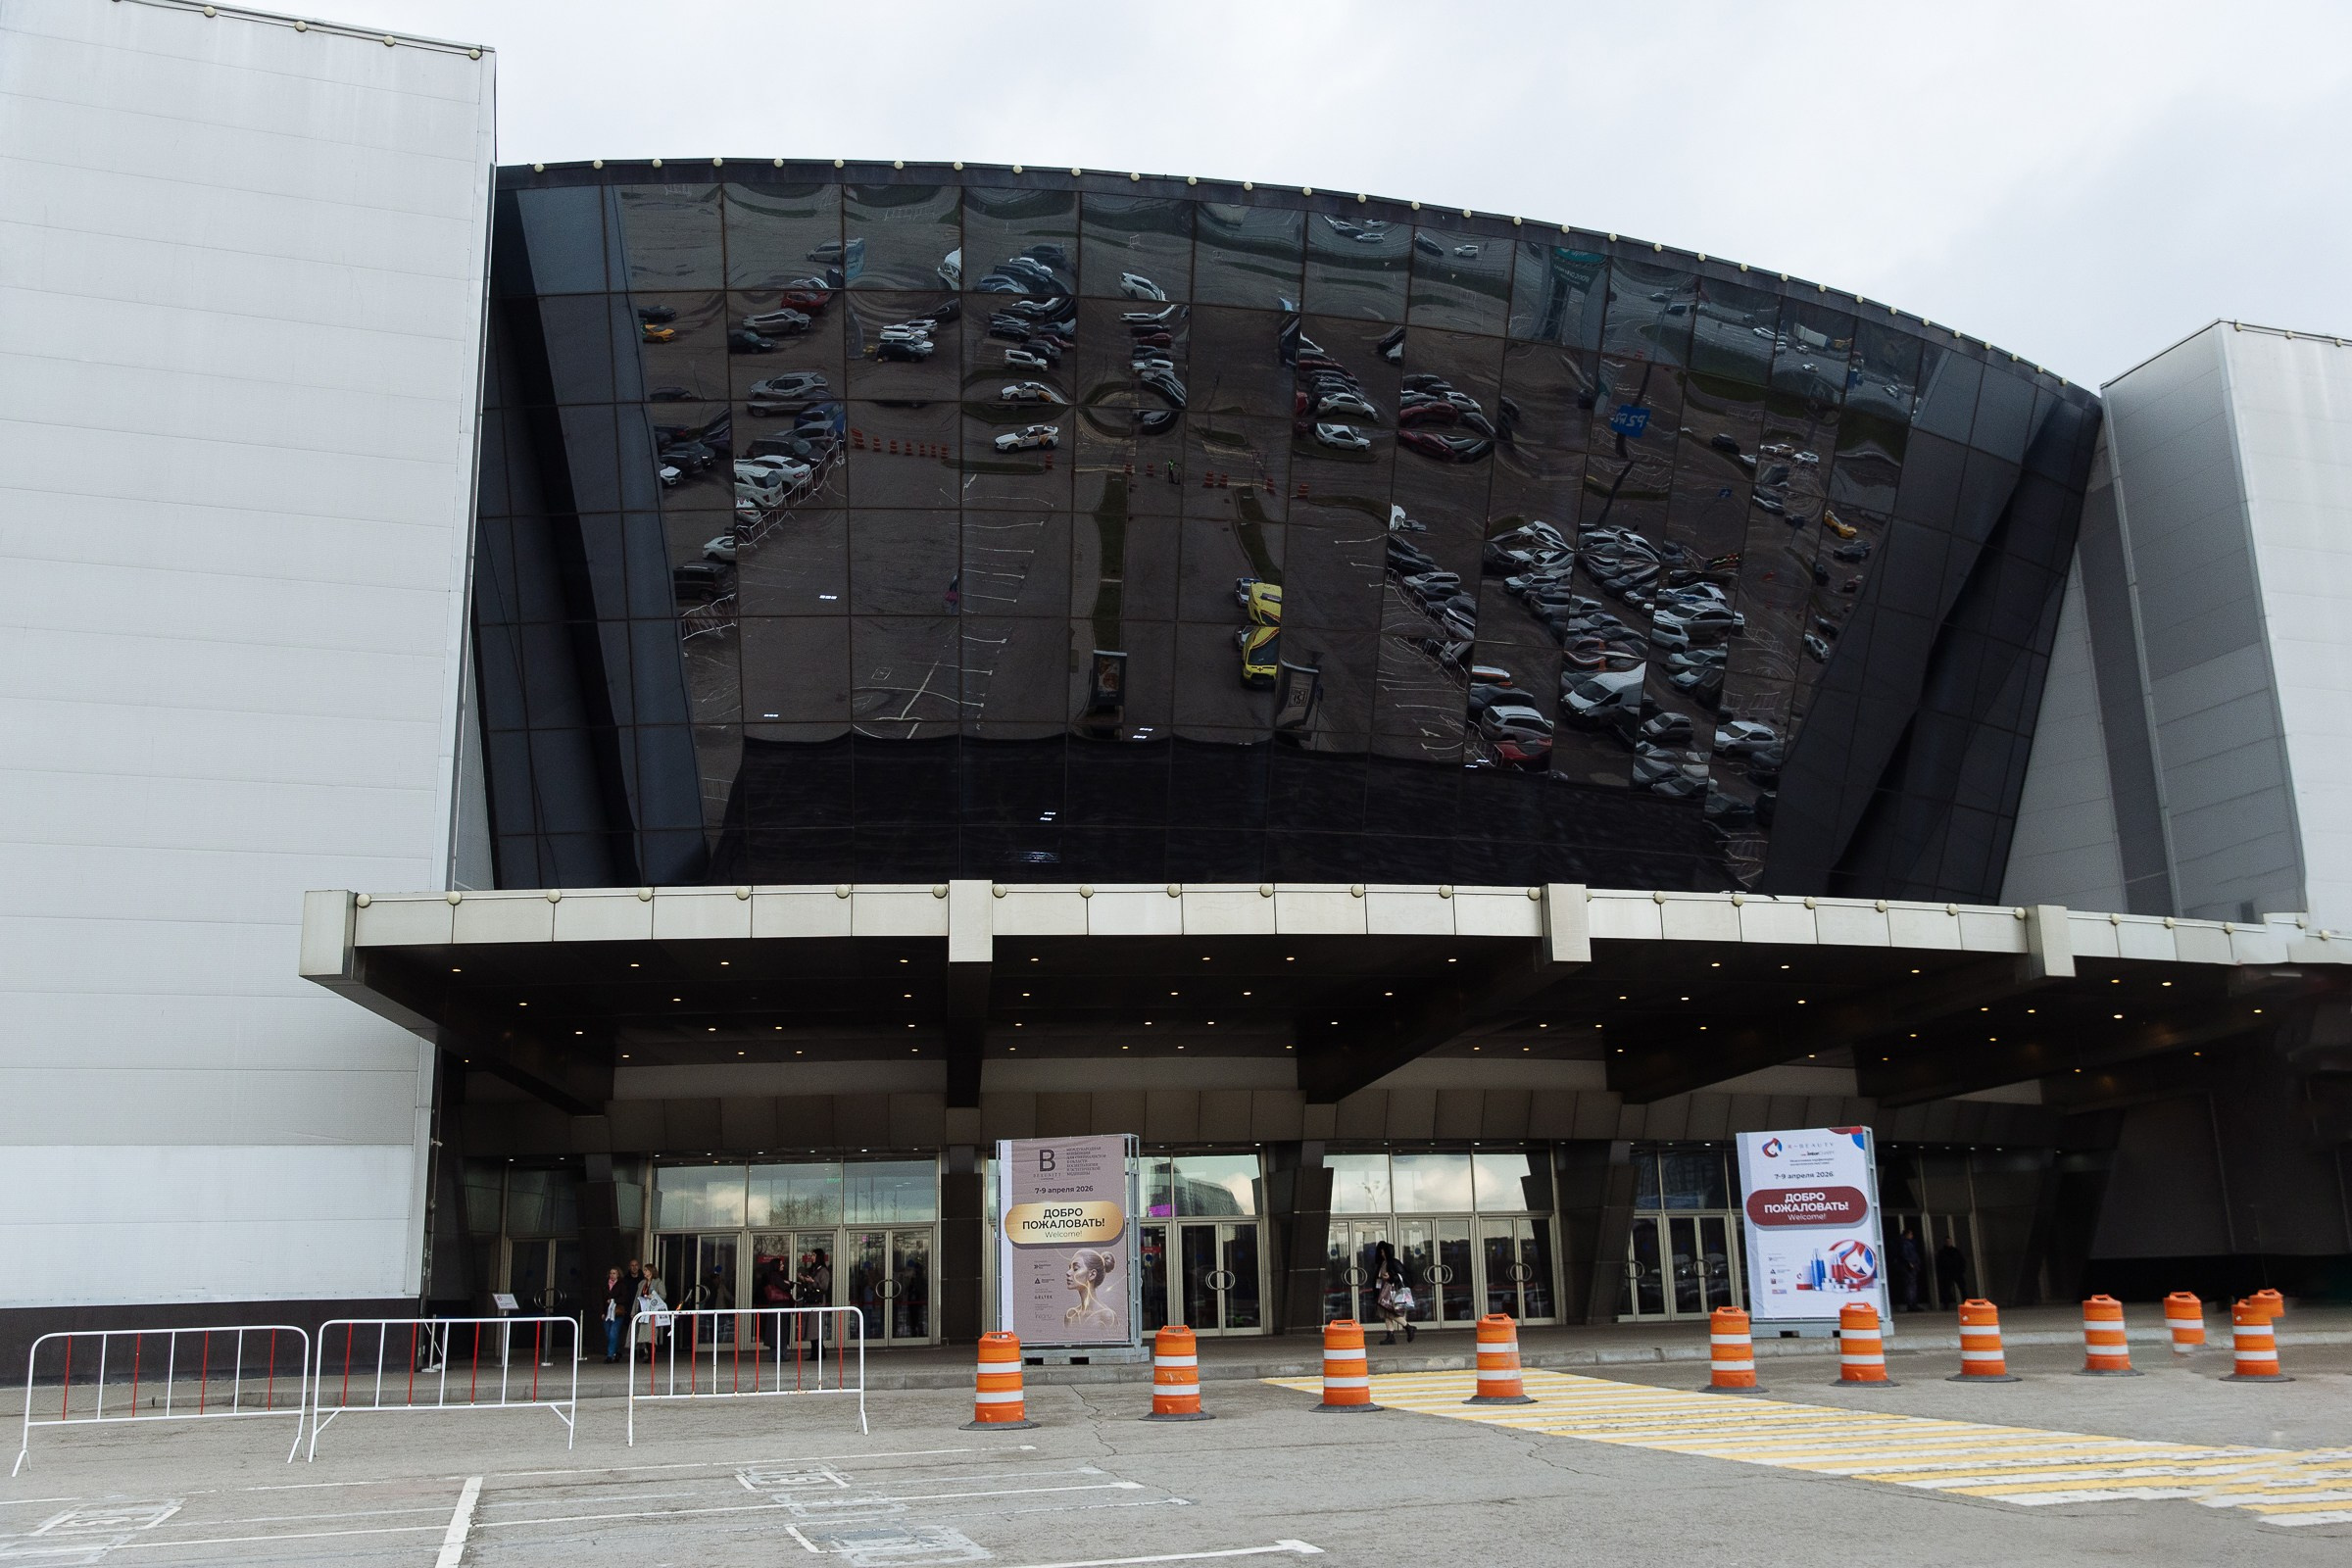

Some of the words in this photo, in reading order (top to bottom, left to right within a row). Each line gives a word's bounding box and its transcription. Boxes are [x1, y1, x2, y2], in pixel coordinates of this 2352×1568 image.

[1039, 1149, 1055, 1172] B
[1785, 1192, 1826, 1203] ДОБРО
[1044, 1207, 1083, 1219] ДОБРО
[1764, 1201, 1849, 1214] ПОЖАЛОВАТЬ!
[1787, 1212, 1827, 1221] Welcome!
[1022, 1218, 1105, 1230] ПОЖАЛОВАТЬ!
